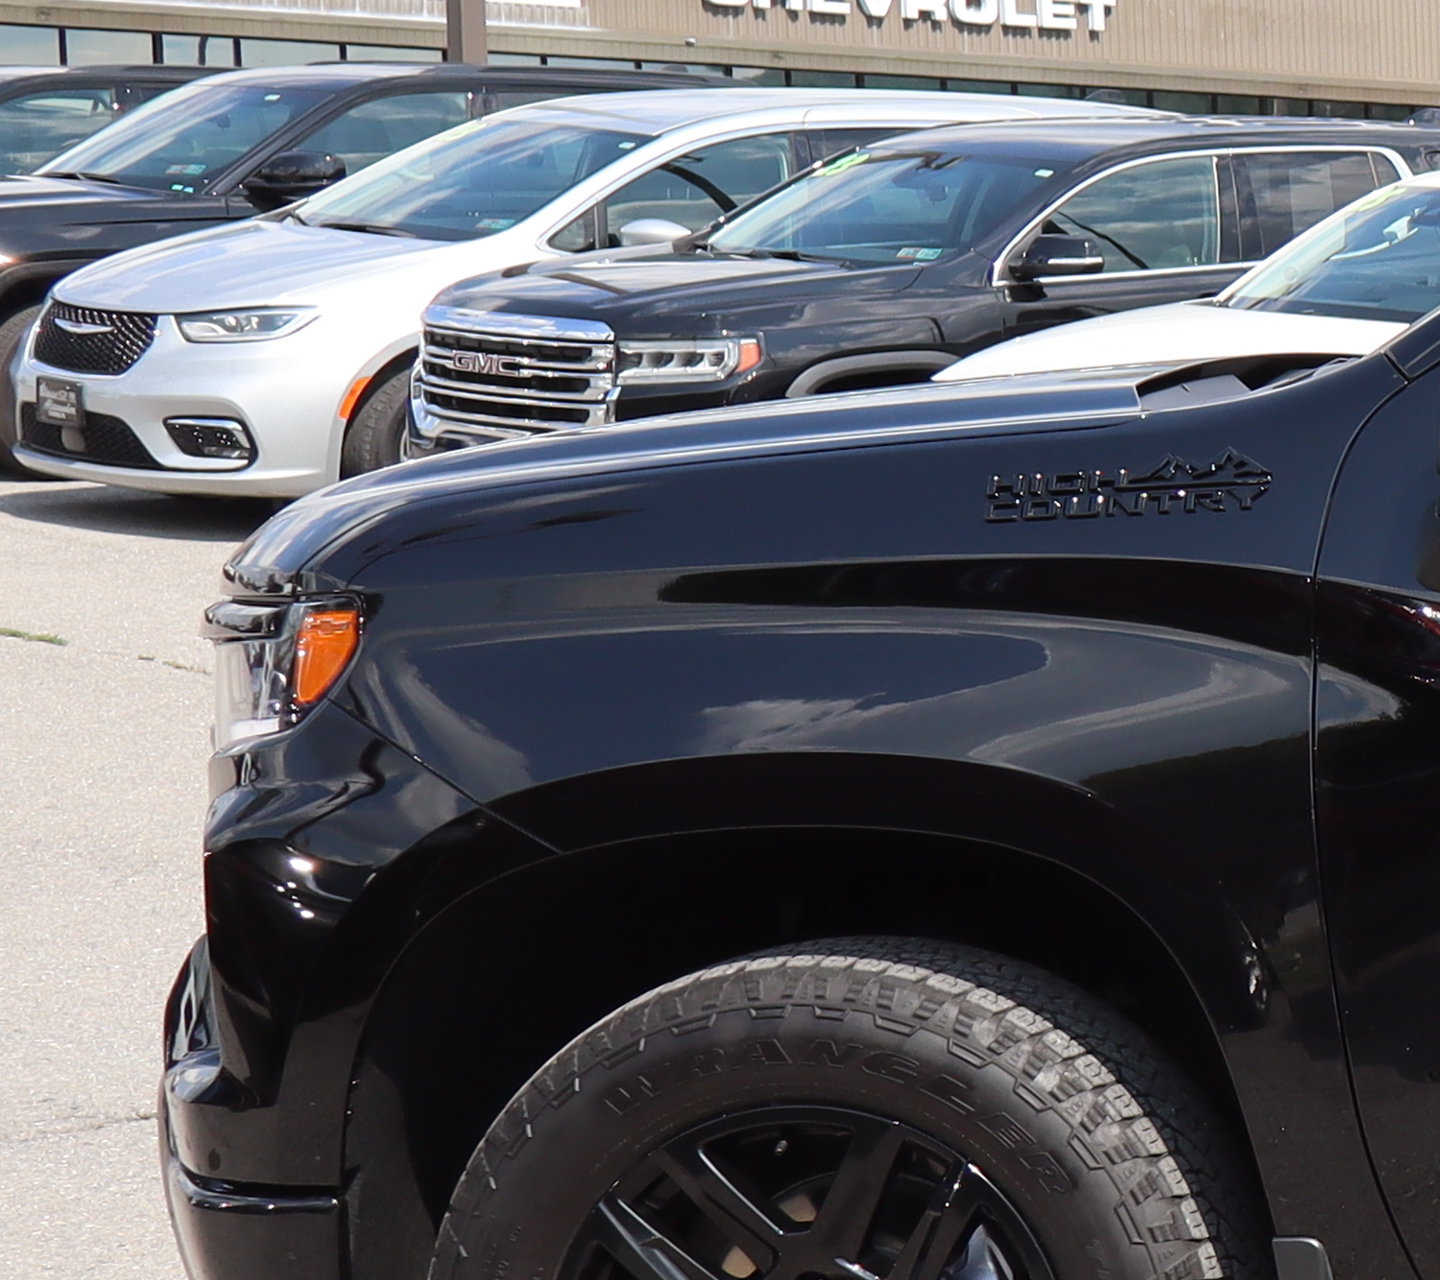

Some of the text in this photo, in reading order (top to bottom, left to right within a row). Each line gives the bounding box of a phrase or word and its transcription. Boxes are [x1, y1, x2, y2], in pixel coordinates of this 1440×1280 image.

[453, 350, 519, 377] GMC
[986, 469, 1129, 498] HIGH
[984, 487, 1268, 522] COUNTRY
[600, 1036, 1076, 1202] WRANGLER
